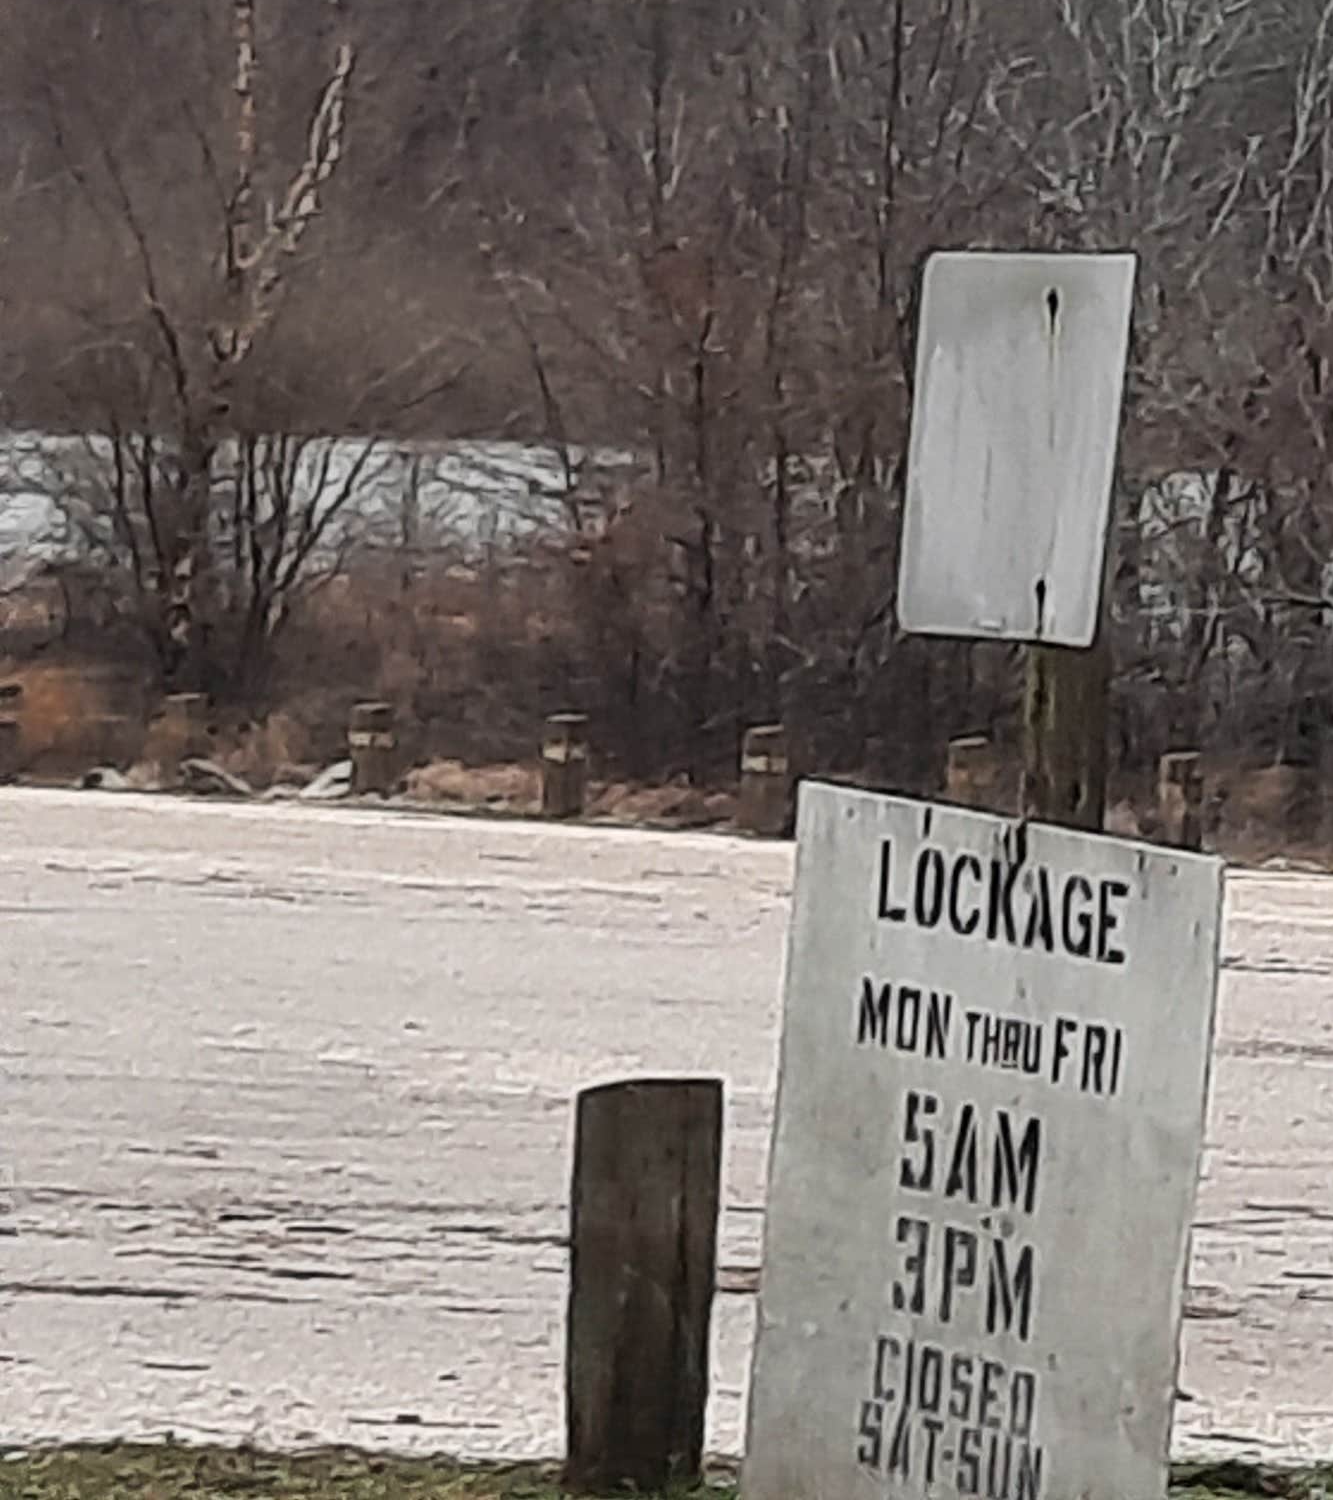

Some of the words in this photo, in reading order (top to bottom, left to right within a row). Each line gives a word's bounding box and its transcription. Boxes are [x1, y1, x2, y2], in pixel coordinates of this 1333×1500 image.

[877, 838, 1129, 965] LOCKAGE
[857, 976, 953, 1060] MON
[1051, 1016, 1122, 1096] FRI
[899, 1090, 1041, 1215] 5AM
[892, 1216, 1034, 1342] 3PM
